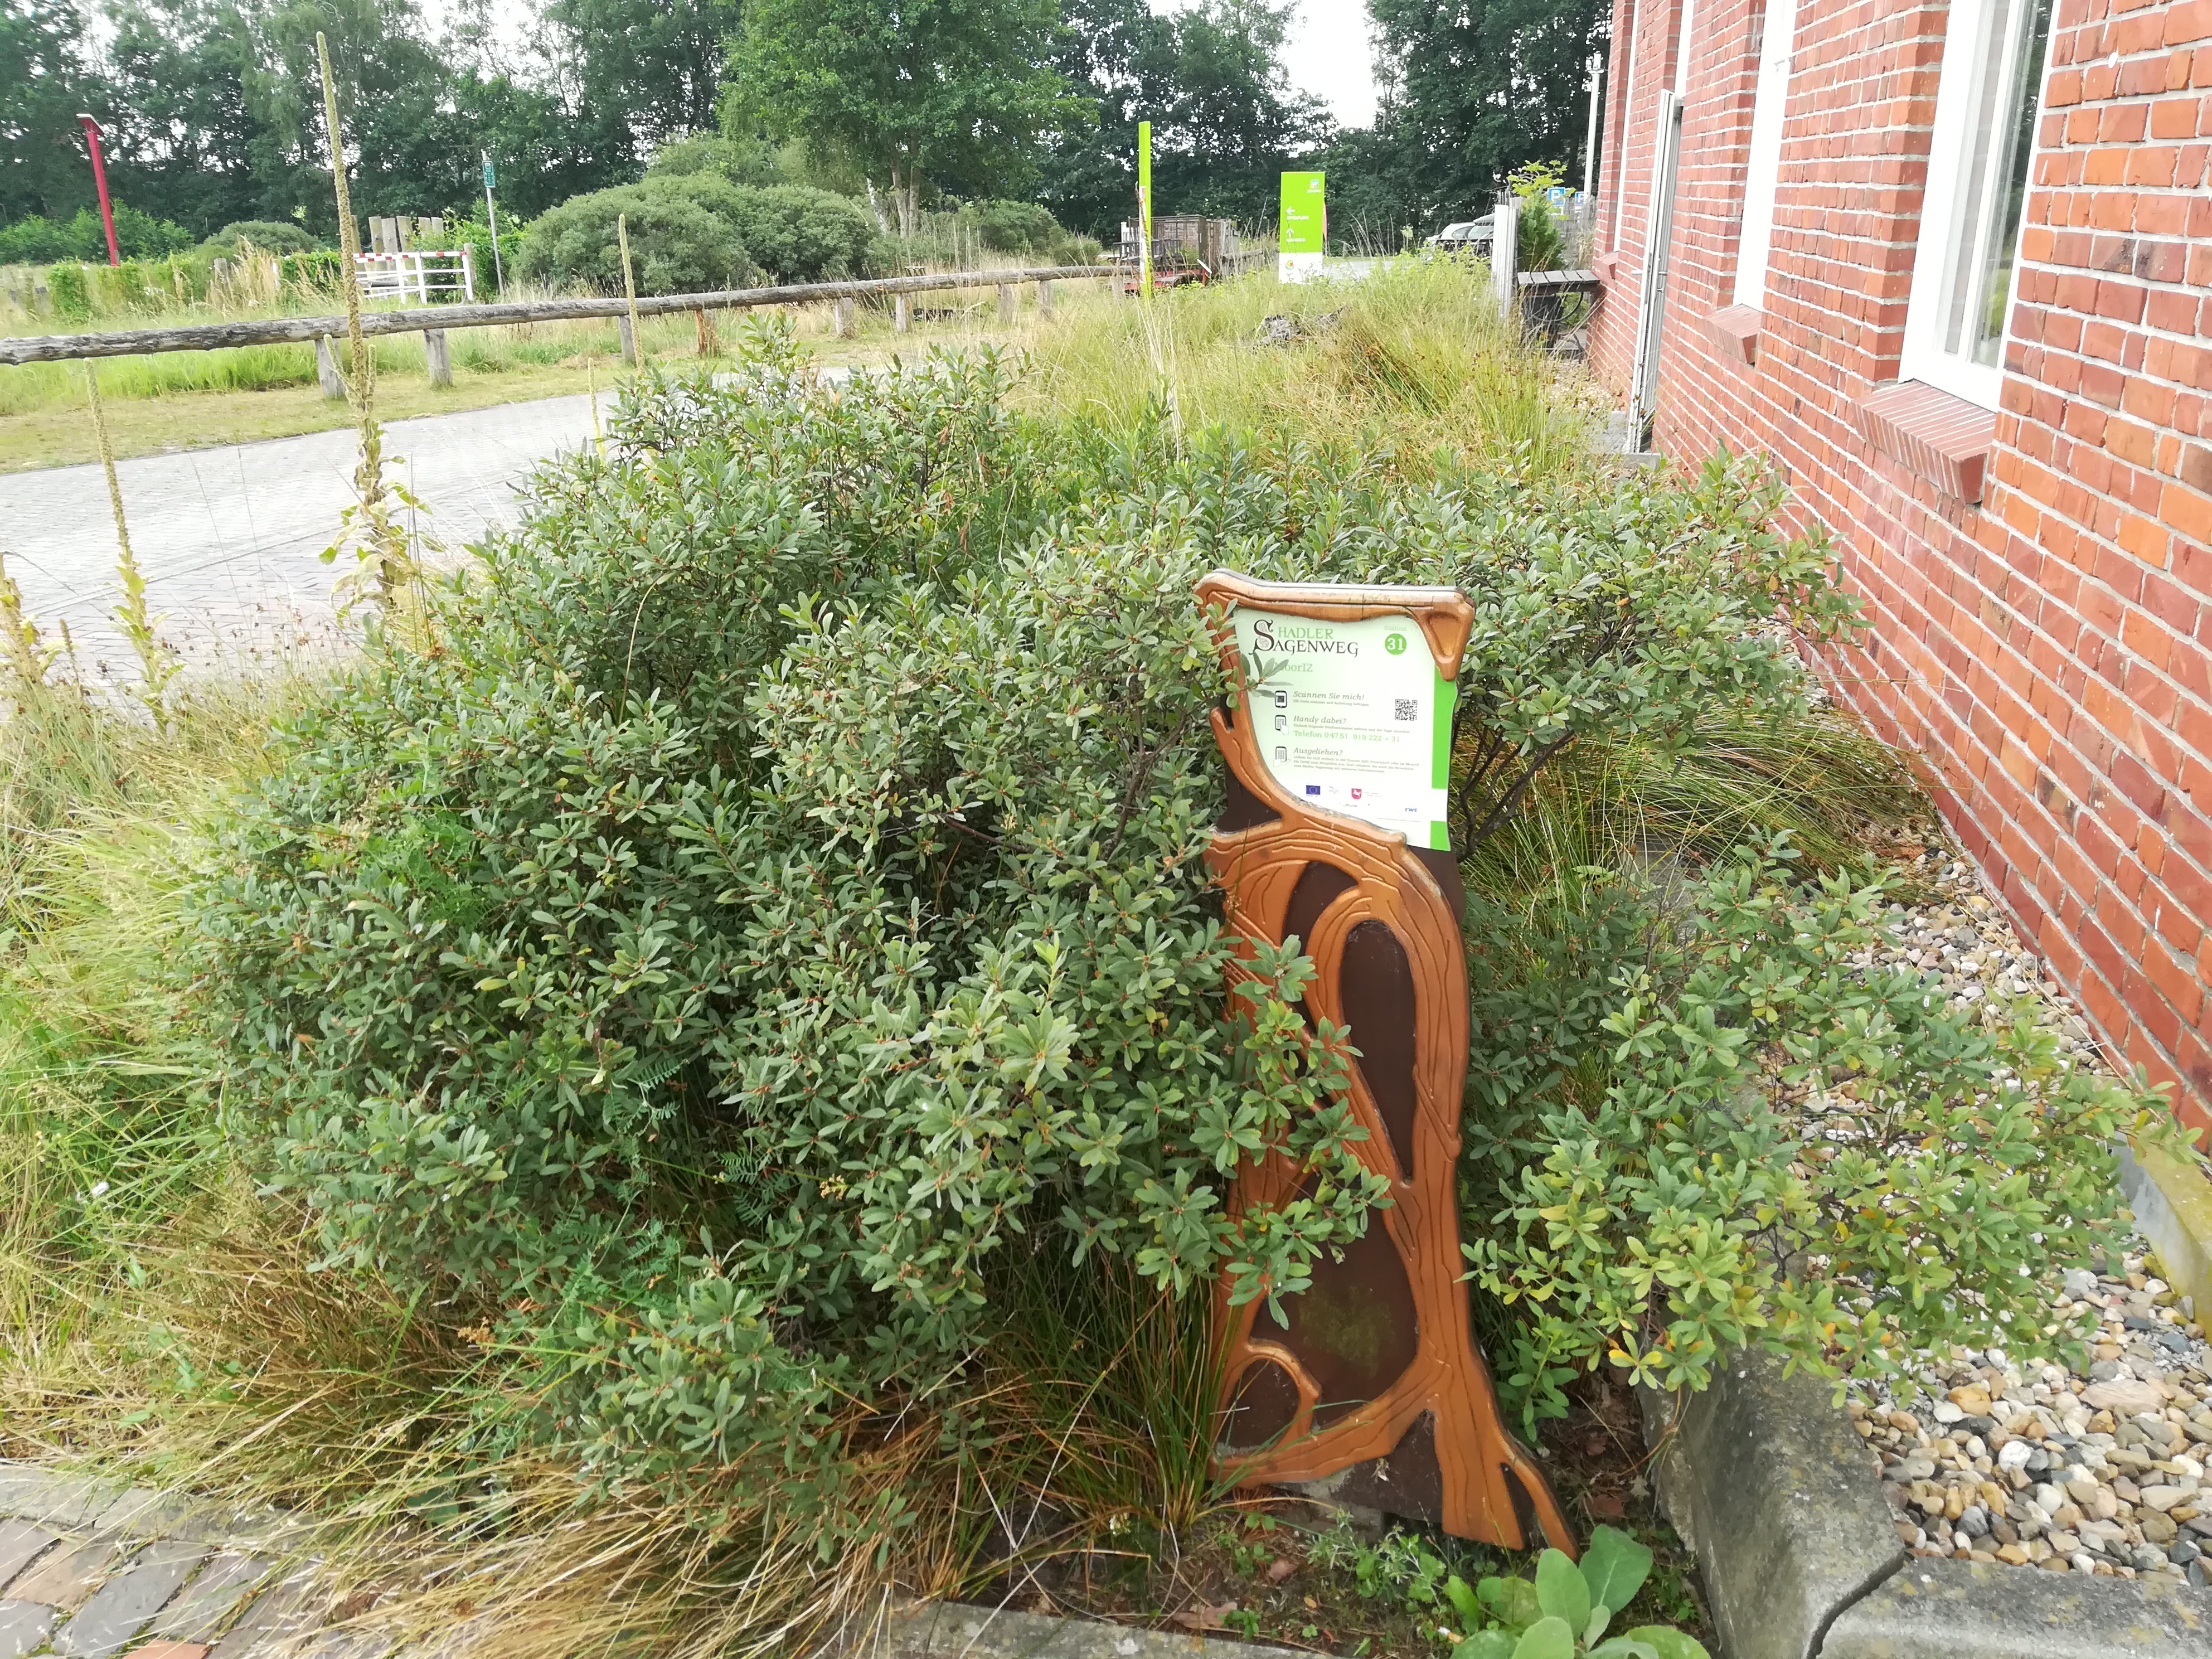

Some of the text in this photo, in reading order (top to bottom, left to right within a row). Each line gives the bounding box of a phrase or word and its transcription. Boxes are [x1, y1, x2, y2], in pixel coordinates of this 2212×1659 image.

[1248, 619, 1359, 658] SAGENWEG
[1387, 637, 1403, 651] 31
[1293, 691, 1327, 699] Scannen
[1293, 715, 1320, 725] Handy
[1293, 747, 1343, 756] Ausgeliehen?
